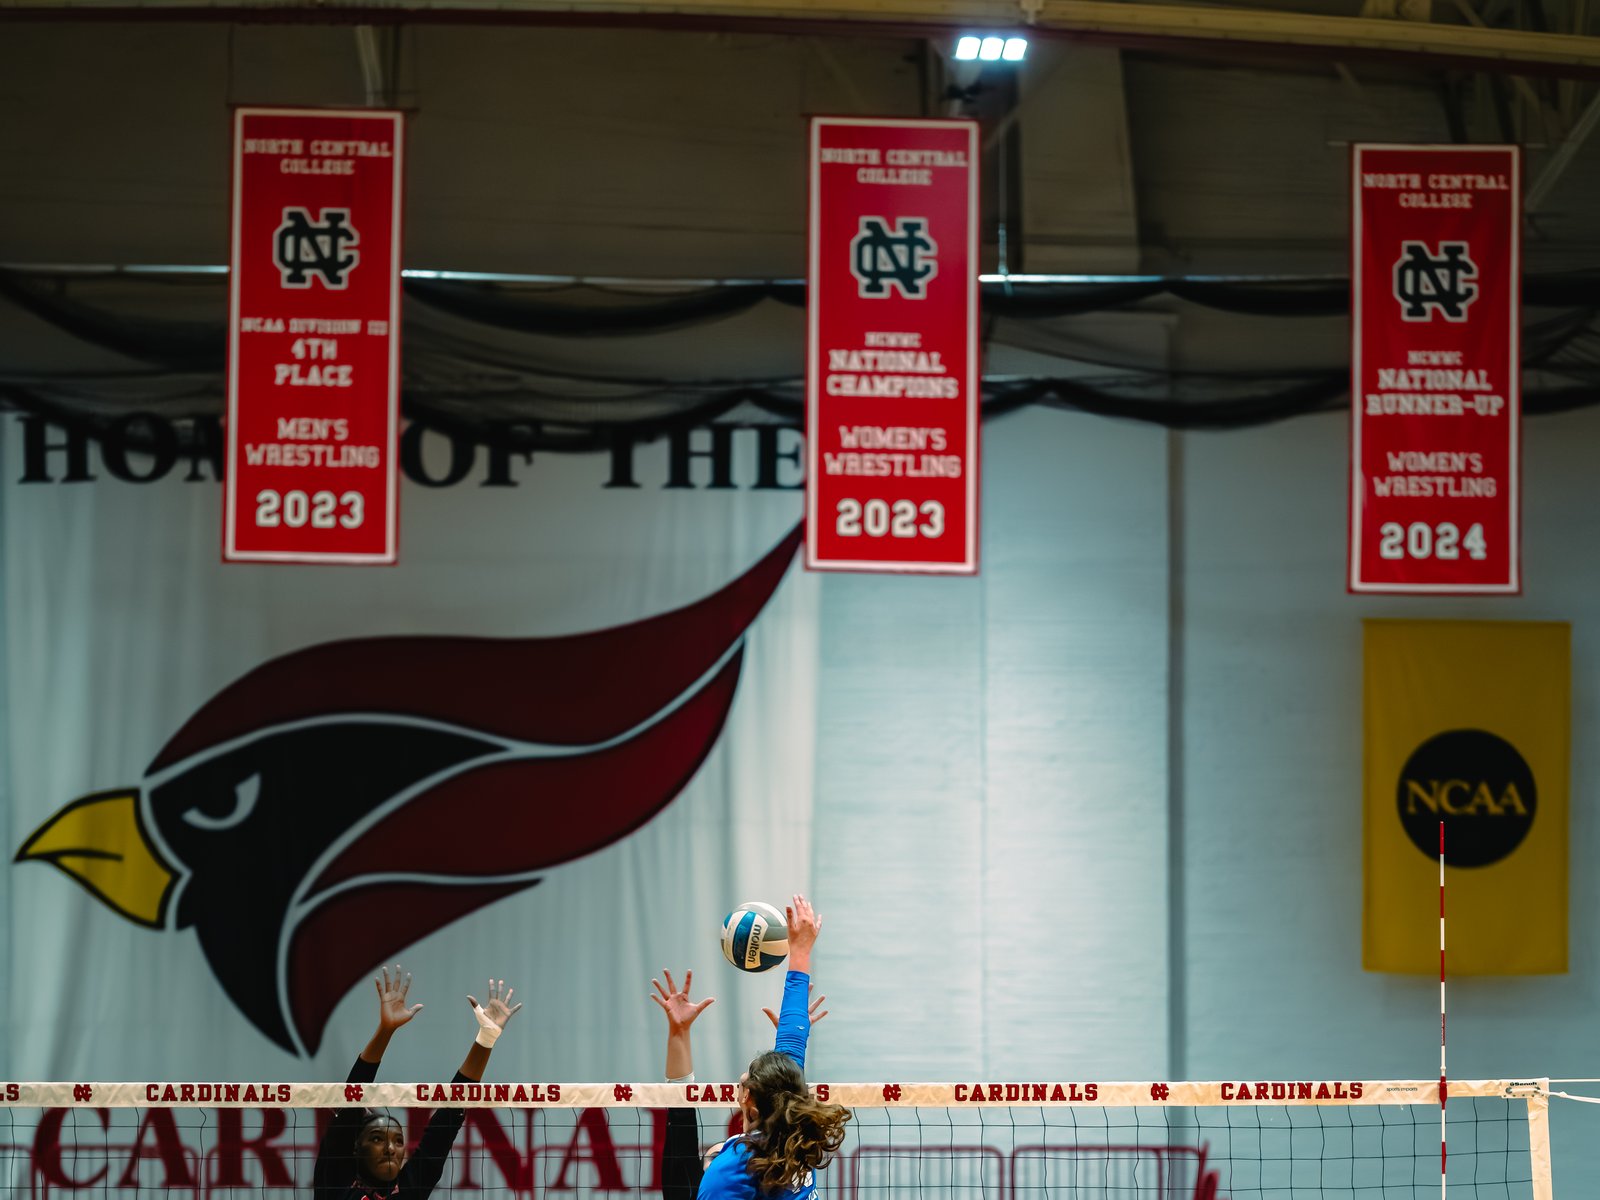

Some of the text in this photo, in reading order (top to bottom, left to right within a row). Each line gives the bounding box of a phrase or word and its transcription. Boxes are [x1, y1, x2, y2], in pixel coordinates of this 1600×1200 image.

[244, 139, 392, 157] NORTH CENTRAL
[821, 148, 969, 168] NORTH CENTRAL
[280, 158, 355, 175] COLLEGE
[1363, 173, 1509, 190] NORTH CENTRAL
[1399, 192, 1472, 208] COLLEGE
[291, 337, 338, 360] 4TH
[829, 349, 947, 374] NATIONAL
[274, 363, 354, 387] PLACE
[826, 374, 959, 399] CHAMPIONS
[1377, 368, 1494, 391] NATIONAL
[1365, 393, 1505, 416] RUNNER-UP
[277, 417, 349, 441] MEN'S
[838, 425, 948, 451] WOMEN'S
[245, 443, 380, 469] WRESTLING
[823, 452, 962, 479] WRESTLING
[1387, 451, 1484, 474] WOMEN'S
[1373, 475, 1498, 498] WRESTLING
[255, 488, 366, 530] 2023
[835, 497, 946, 539] 2023
[1379, 521, 1488, 561] 2024
[1405, 779, 1528, 815] NCAA
[747, 924, 762, 963] molten
[146, 1084, 291, 1102] CARDINALS
[416, 1084, 561, 1102] CARDINALS
[954, 1083, 1098, 1102] CARDINALS
[1220, 1082, 1363, 1101] CARDINALS
